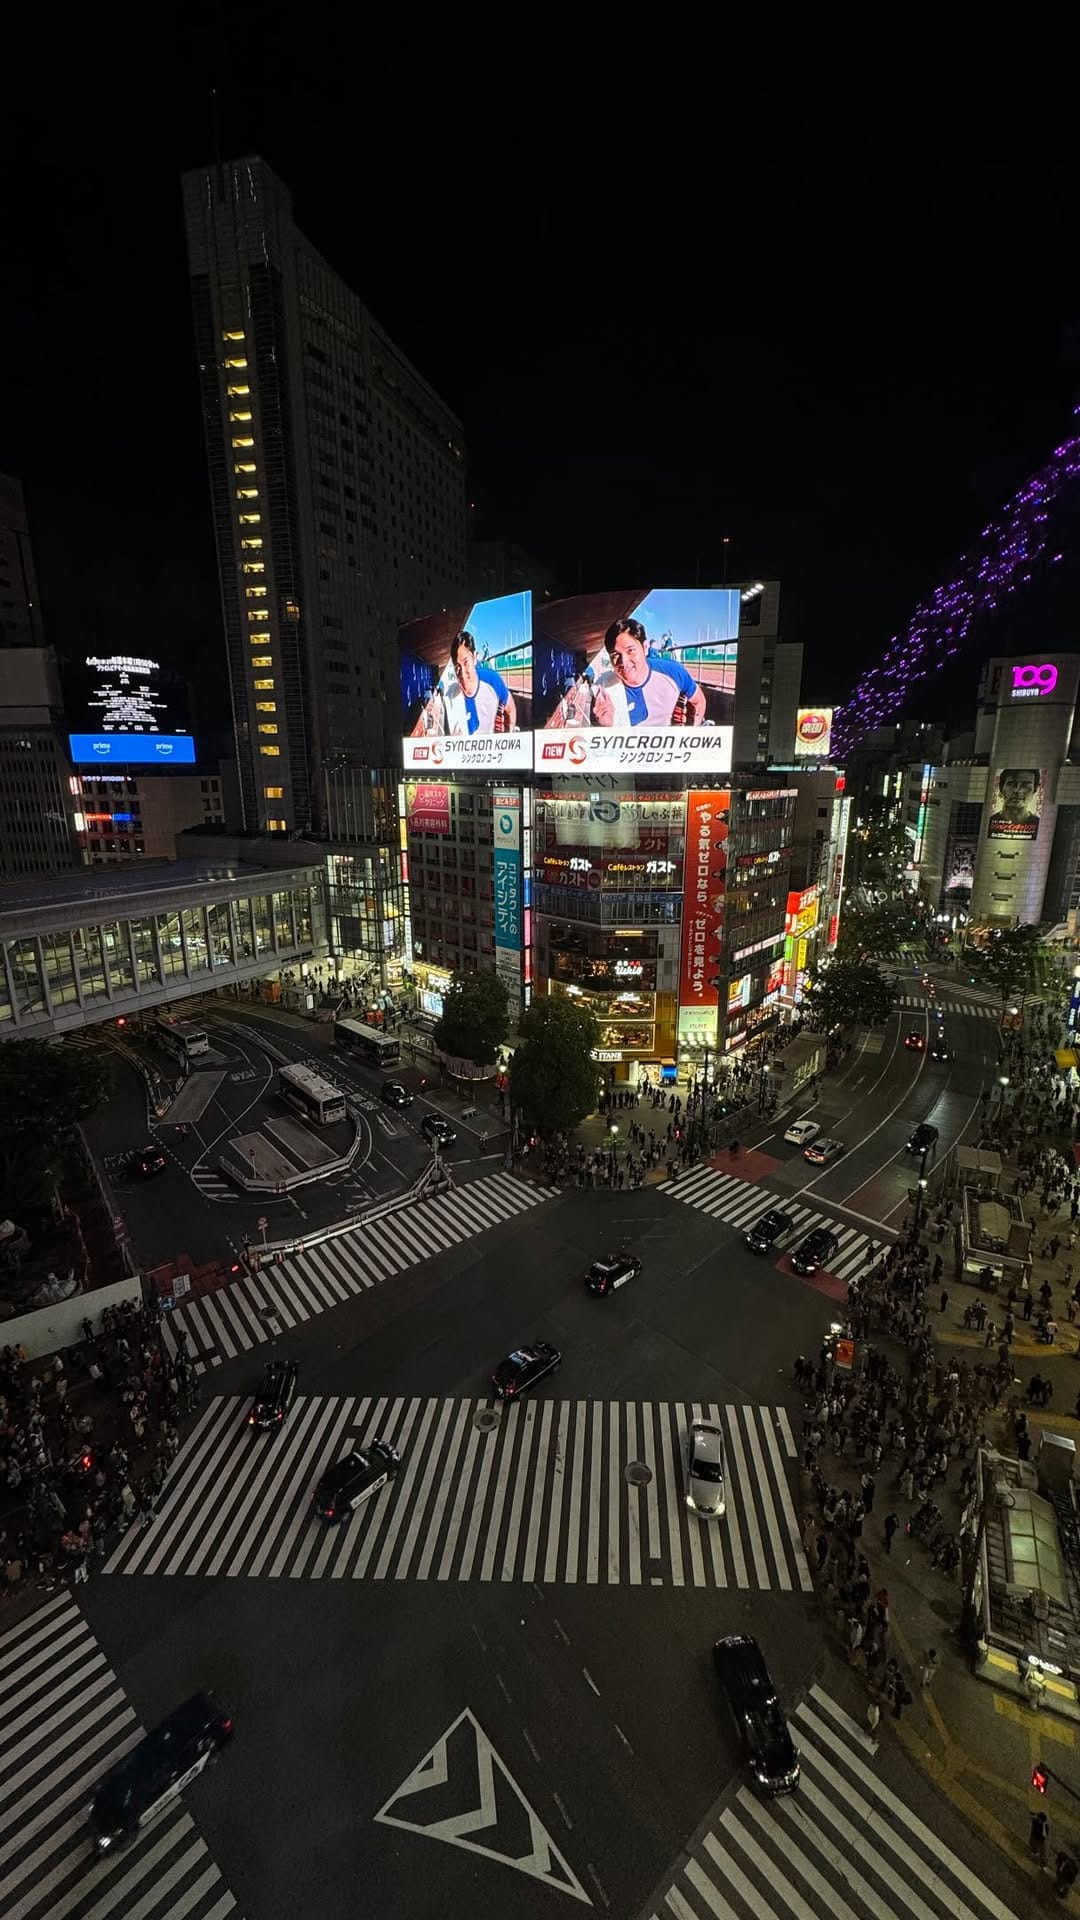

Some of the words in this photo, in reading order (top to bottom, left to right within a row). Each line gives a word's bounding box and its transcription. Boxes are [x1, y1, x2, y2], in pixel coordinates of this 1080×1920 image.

[1012, 664, 1058, 695] 109
[1011, 688, 1039, 697] SHIBUYA
[93, 742, 111, 750] prime
[155, 742, 173, 750] prime
[445, 739, 492, 752] SYNCRON
[495, 739, 521, 750] KOWA
[590, 736, 675, 749] SYNCRON
[679, 736, 722, 749] KOWA
[545, 746, 563, 757] NEW
[620, 751, 692, 763] シンクロンコーワ
[461, 753, 503, 763] シンクロンコーワ
[569, 857, 592, 871] ガスト
[646, 861, 676, 873] ガスト
[496, 861, 508, 933] アイシティ
